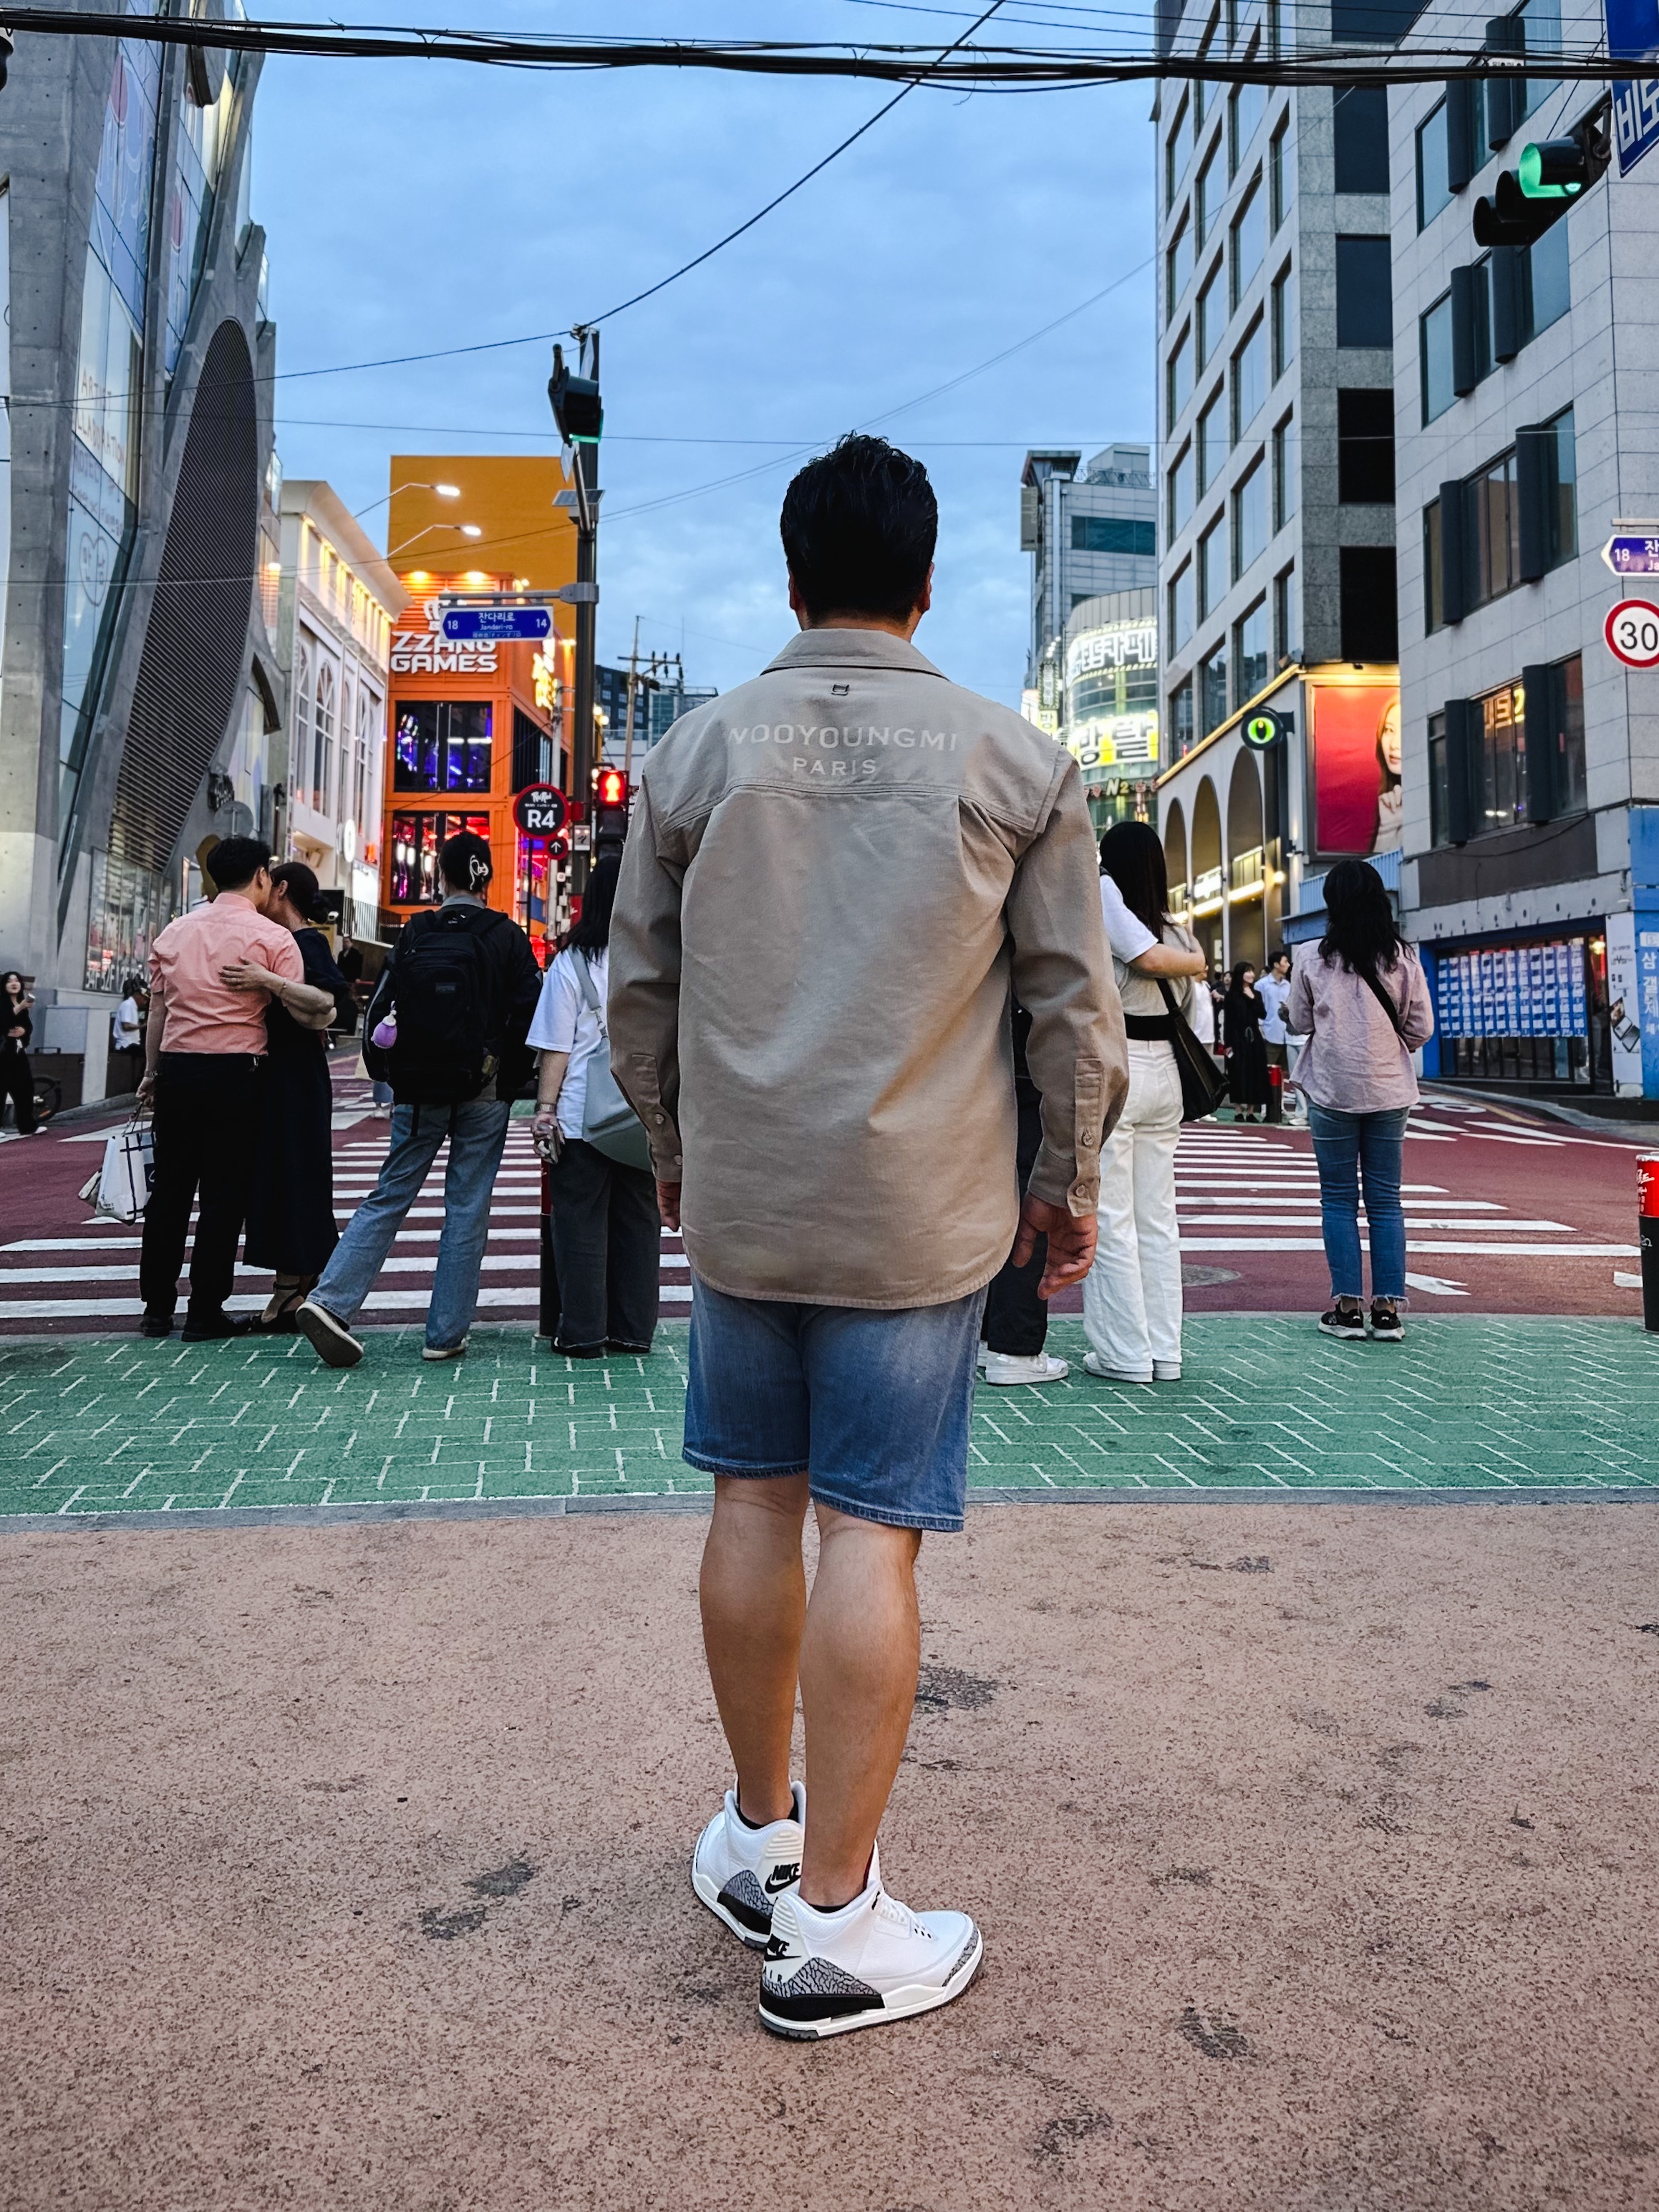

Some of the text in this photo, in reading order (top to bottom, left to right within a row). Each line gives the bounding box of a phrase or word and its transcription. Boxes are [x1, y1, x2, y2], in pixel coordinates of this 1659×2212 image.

[1614, 548, 1630, 562] 18
[447, 612, 548, 630] 18 잔다리로 14
[1620, 621, 1658, 652] 30
[391, 654, 498, 674] GAMES
[793, 756, 877, 776] PARIS
[527, 810, 555, 829] R4
[771, 1862, 801, 1881] NIKE
